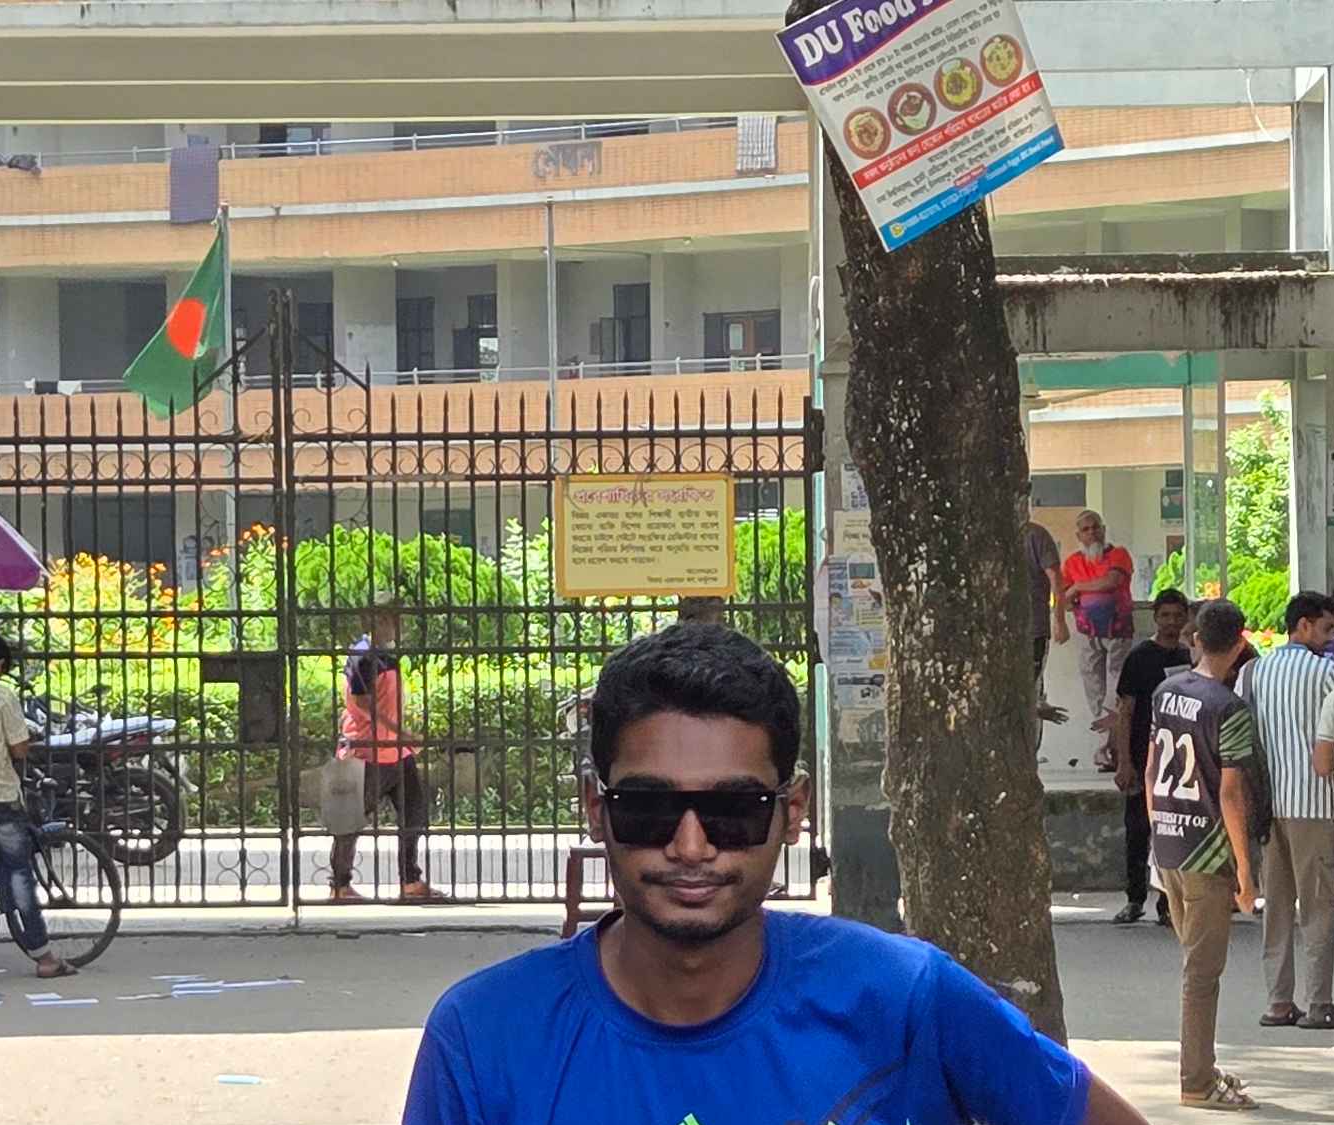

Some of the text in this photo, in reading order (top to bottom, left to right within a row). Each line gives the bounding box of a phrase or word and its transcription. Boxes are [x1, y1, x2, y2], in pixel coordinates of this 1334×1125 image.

[794, 0, 916, 67] DU Food
[1153, 728, 1200, 801] 22
[1192, 815, 1209, 828] OF
